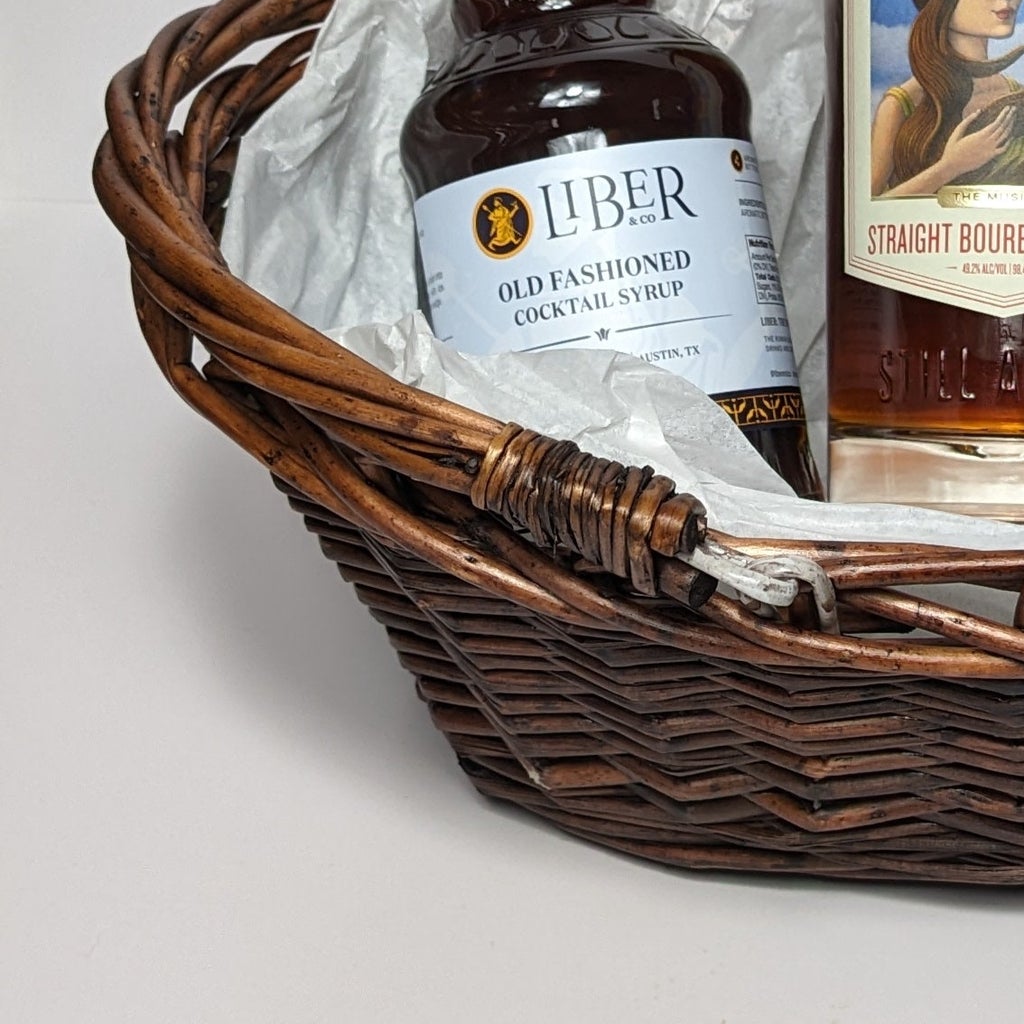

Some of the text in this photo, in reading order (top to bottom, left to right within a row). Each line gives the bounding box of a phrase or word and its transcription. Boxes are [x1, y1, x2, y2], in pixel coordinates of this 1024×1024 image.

[537, 165, 699, 240] LIBER
[952, 192, 981, 202] THE
[628, 213, 656, 226] & CO
[868, 223, 953, 256] STRAIGHT
[498, 249, 691, 304] OLD FASHIONED
[962, 263, 981, 274] 49.2%
[982, 263, 1008, 275] ALC/VOL
[514, 280, 684, 327] COCKTAIL SYRUP
[684, 345, 701, 357] TX
[878, 347, 977, 404] STILL
